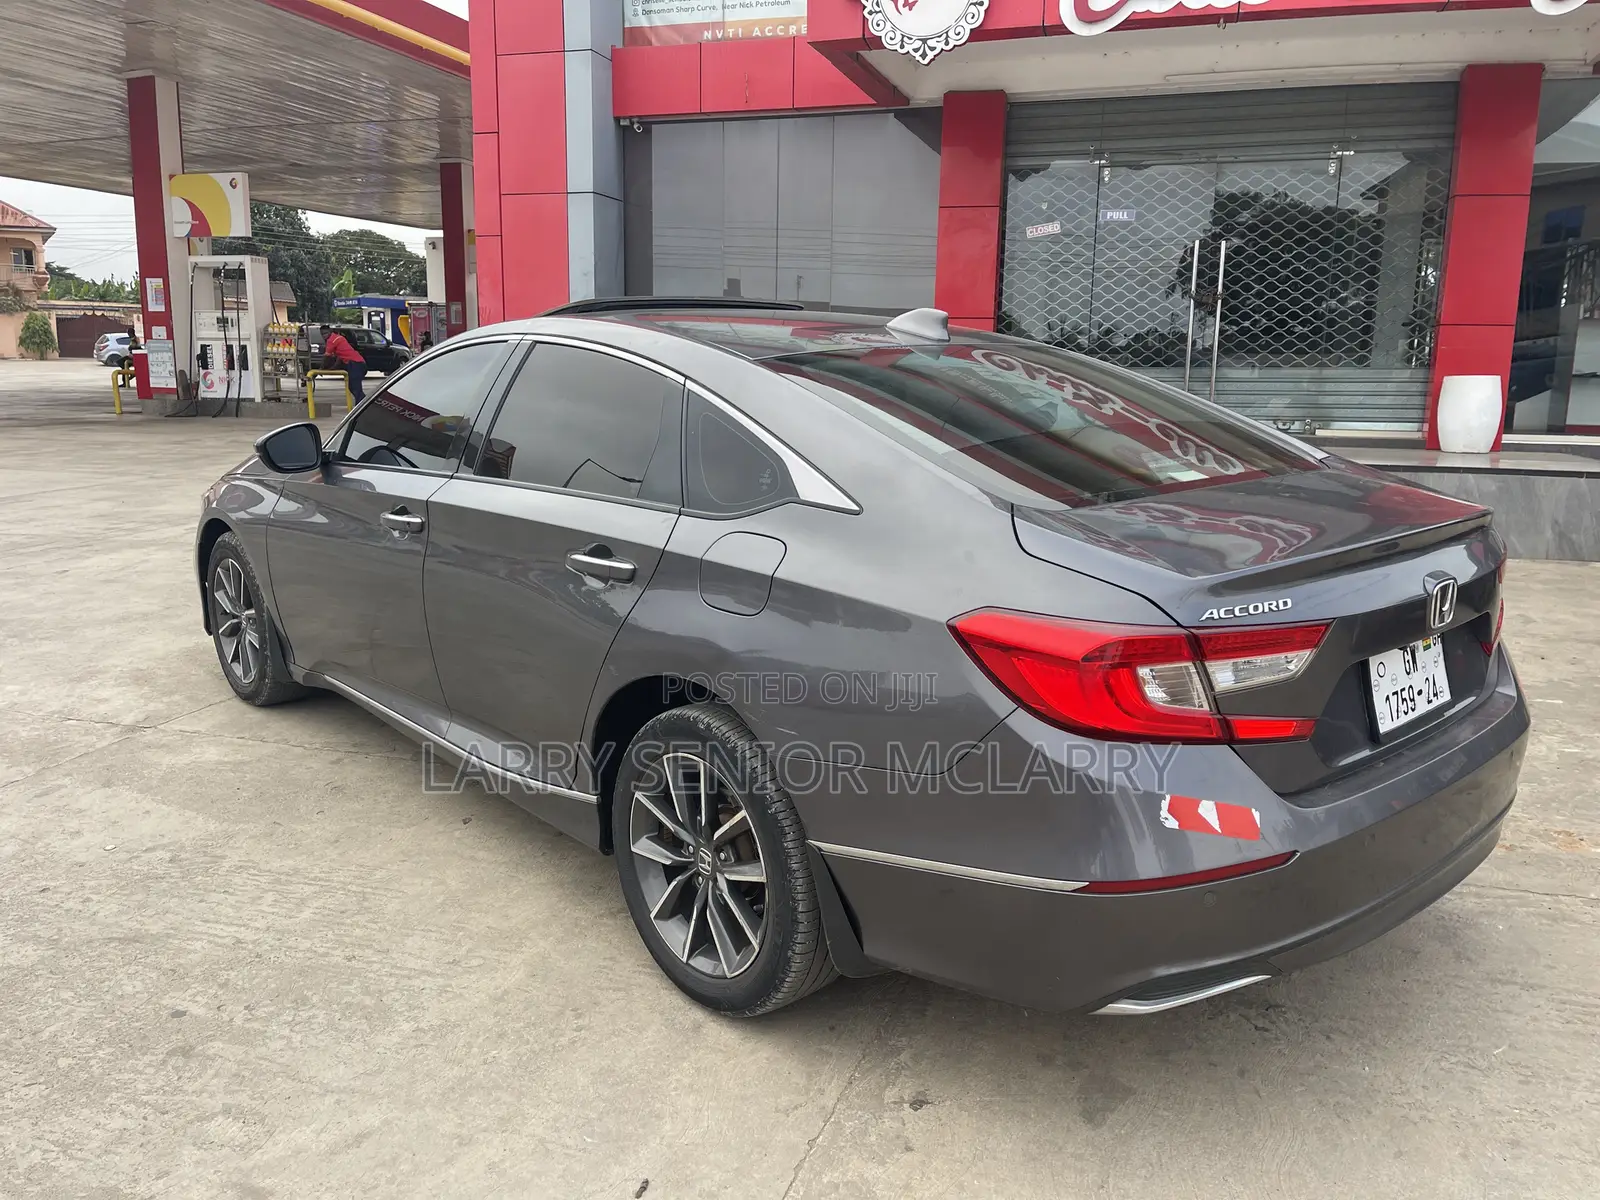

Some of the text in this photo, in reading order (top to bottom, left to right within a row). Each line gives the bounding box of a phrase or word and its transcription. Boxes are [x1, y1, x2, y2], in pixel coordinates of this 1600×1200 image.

[641, 7, 675, 16] Dansoman
[675, 6, 695, 14] Sharp
[696, 4, 718, 12] Curve,
[722, 2, 738, 10] Near
[755, 0, 791, 8] Petroleum
[703, 24, 808, 40] NVTI ACCRE
[1106, 211, 1129, 220] PULL
[1027, 223, 1060, 237] CLOSED
[206, 345, 214, 369] DIESEL
[218, 375, 237, 384] NIK
[1199, 598, 1292, 621] ACCORD
[1385, 673, 1439, 722] 1759-24
